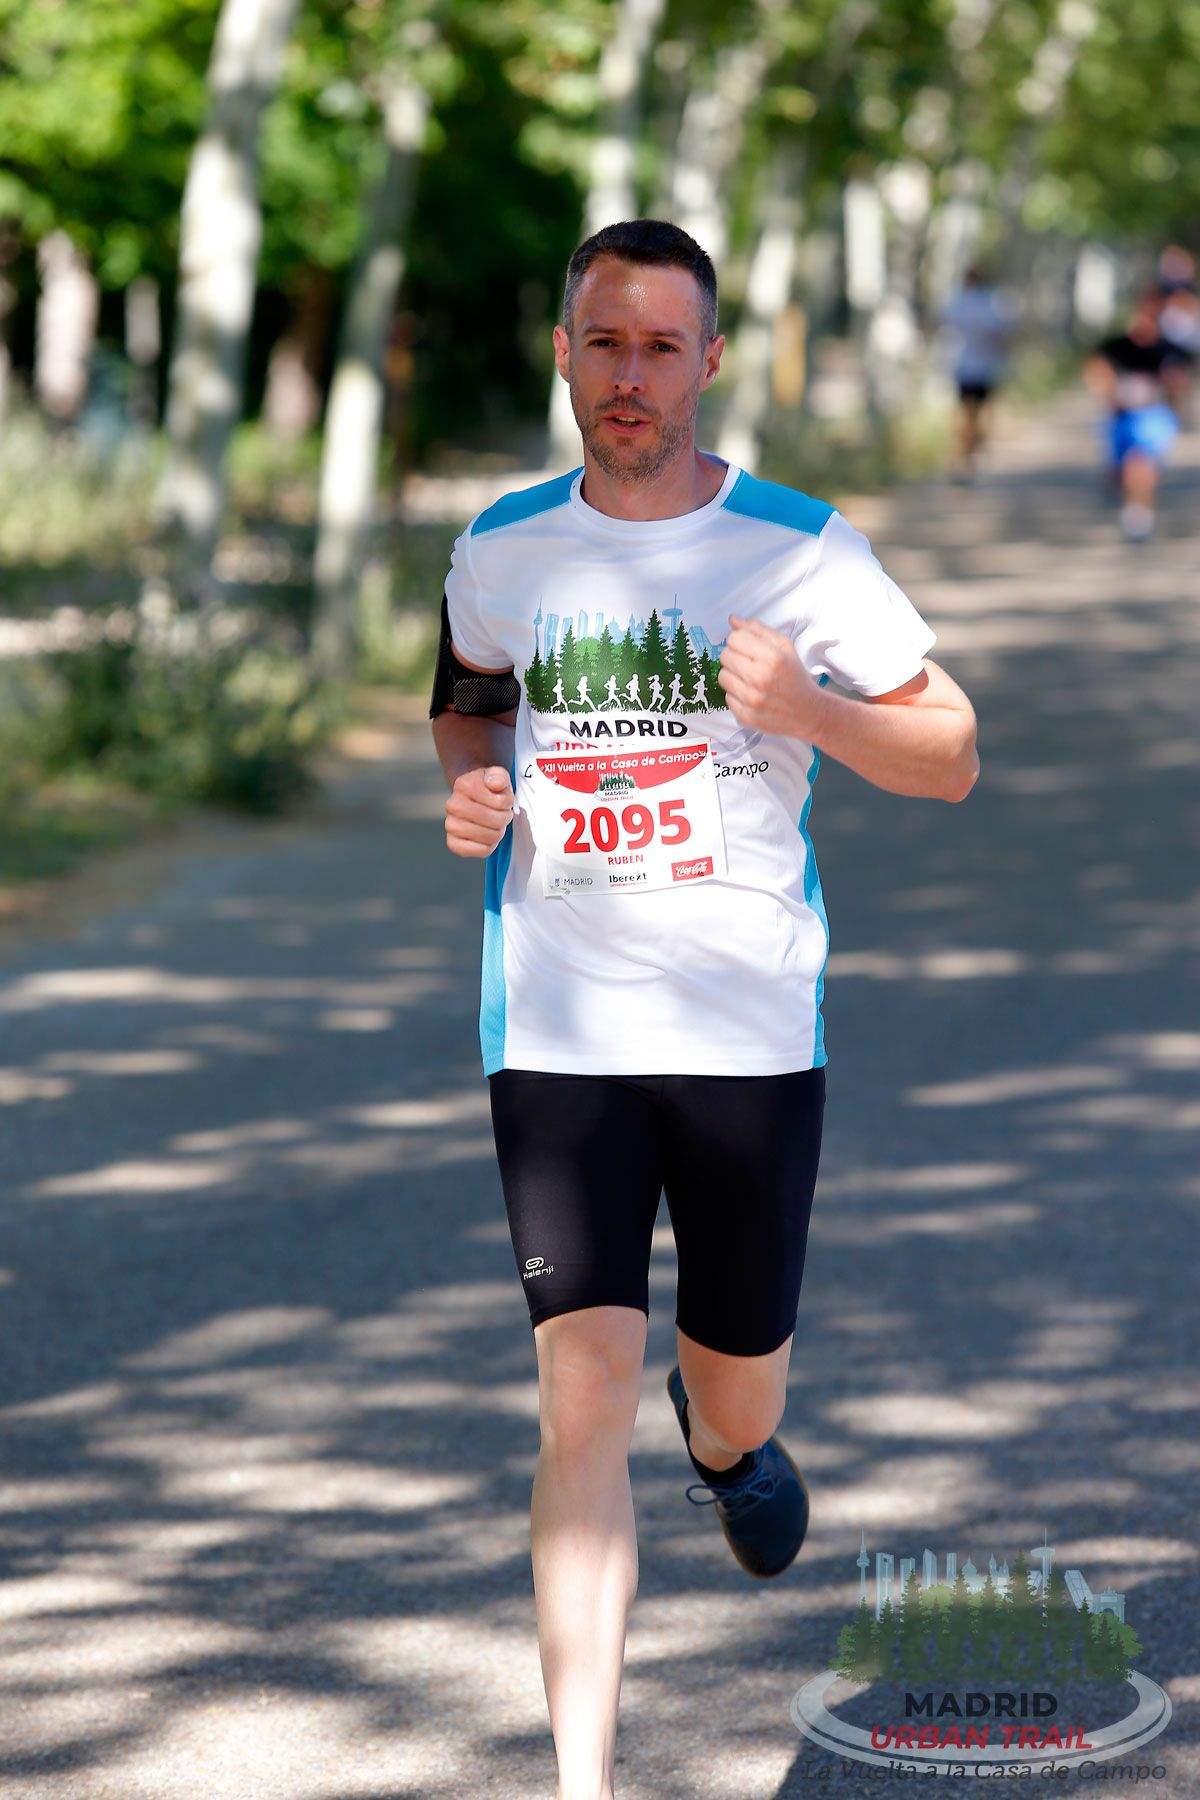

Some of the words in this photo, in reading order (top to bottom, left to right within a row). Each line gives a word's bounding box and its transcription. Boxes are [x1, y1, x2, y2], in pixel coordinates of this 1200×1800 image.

[569, 719, 688, 738] MADRID
[558, 761, 586, 773] Vuelta
[588, 763, 595, 771] a
[597, 760, 607, 771] la
[611, 758, 639, 769] Casa
[641, 756, 656, 767] de
[658, 752, 700, 765] Campo
[560, 799, 692, 853] 2095
[563, 877, 594, 886] MADRID
[609, 872, 648, 883] Iberext
